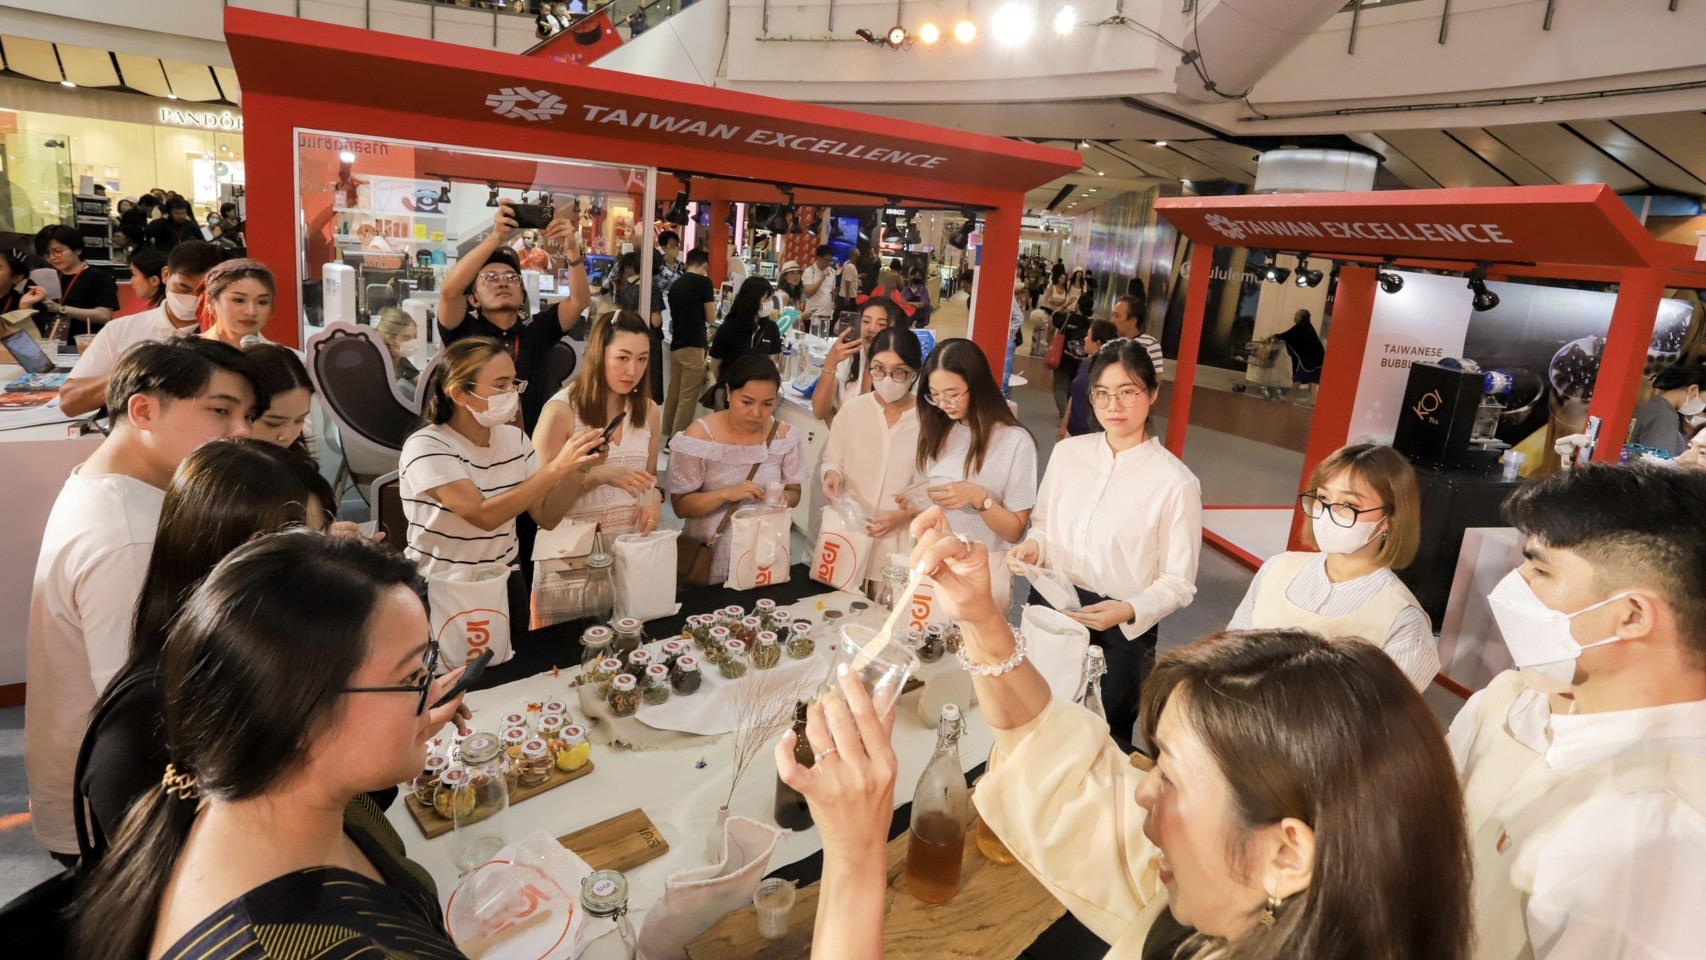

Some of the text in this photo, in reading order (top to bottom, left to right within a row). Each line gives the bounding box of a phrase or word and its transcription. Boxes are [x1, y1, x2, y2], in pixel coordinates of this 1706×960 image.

[161, 108, 243, 130] PANDO
[583, 104, 949, 170] TAIWAN EXCELLENCE
[1234, 219, 1514, 244] TAIWAN EXCELLENCE
[1384, 344, 1443, 357] TAIWANESE
[1380, 358, 1420, 369] BUBBL
[1412, 389, 1443, 421] KOI
